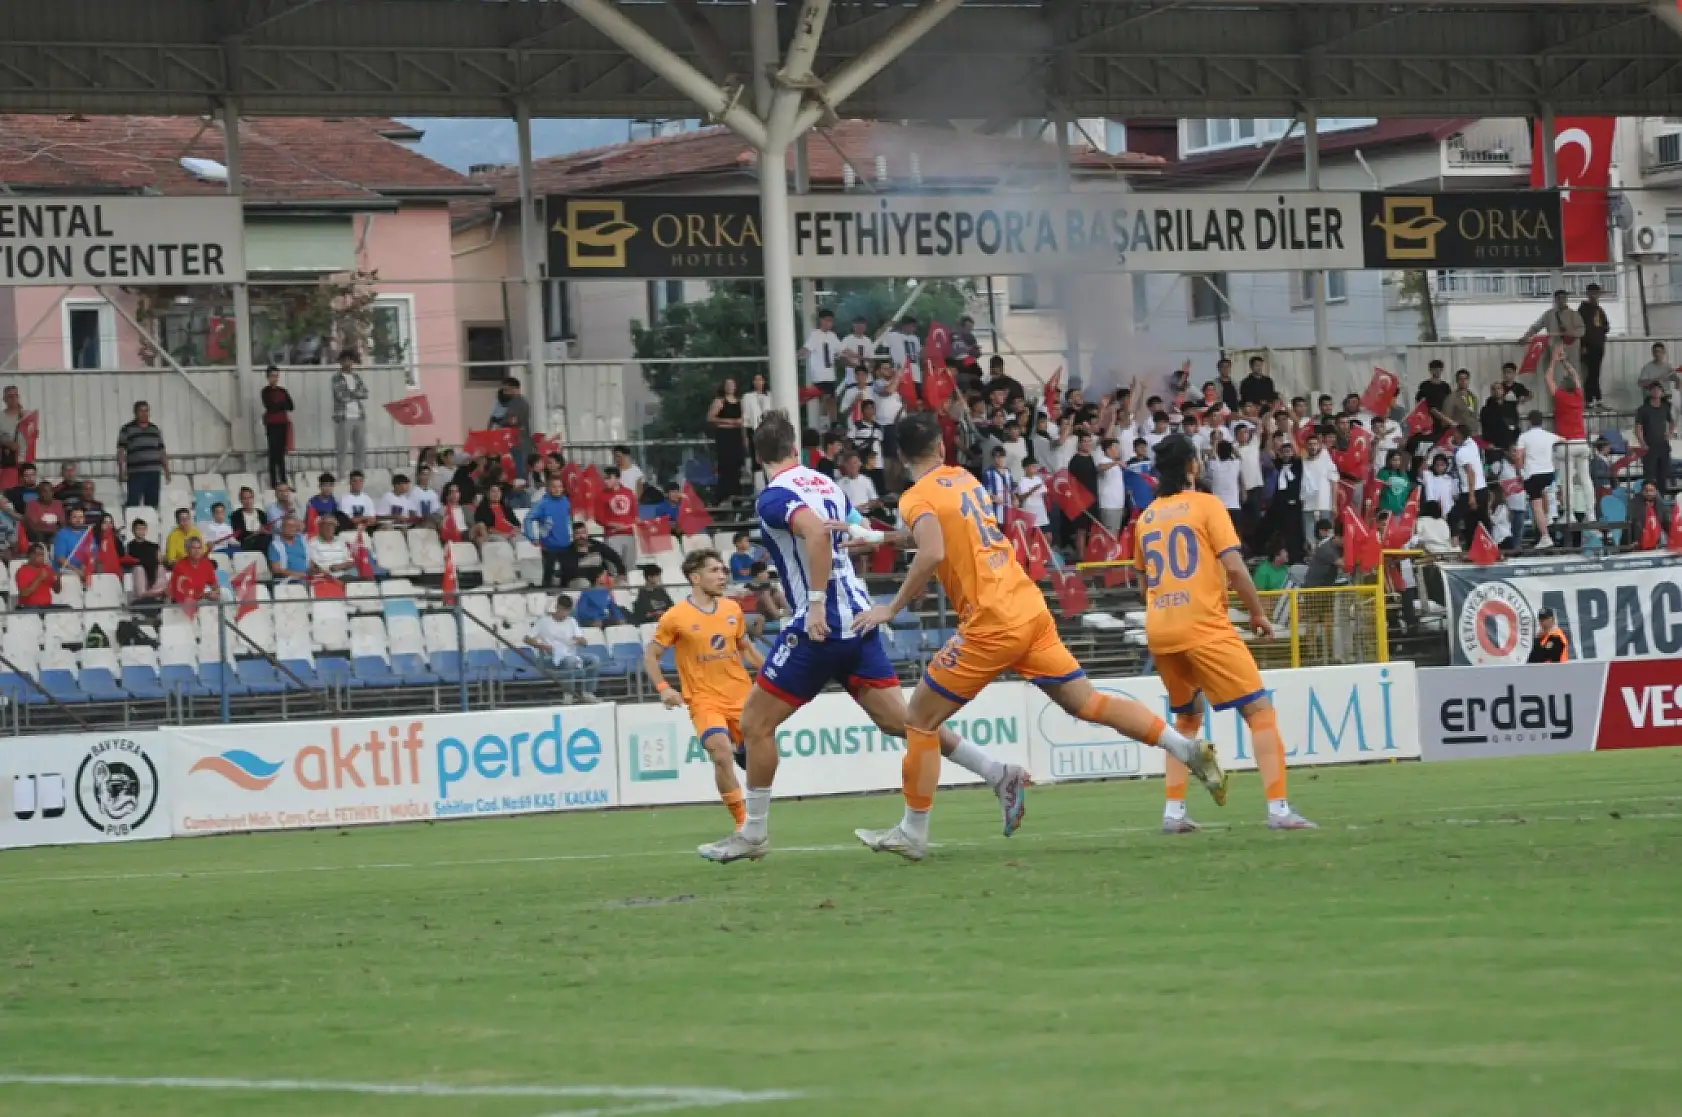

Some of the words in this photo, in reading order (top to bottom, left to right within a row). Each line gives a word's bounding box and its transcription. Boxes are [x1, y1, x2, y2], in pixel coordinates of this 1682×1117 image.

[0, 205, 113, 238] ENTAL
[652, 212, 763, 248] ORKA
[794, 198, 1059, 256] FETHİYESPOR'A
[1065, 207, 1247, 266] BAŞARILAR
[1254, 195, 1345, 250] DİLER
[1458, 208, 1554, 242] ORKA
[0, 243, 73, 278] ION
[84, 242, 225, 278] CENTER
[671, 253, 749, 268] HOTELS
[1475, 245, 1543, 259] HOTELS
[1142, 524, 1199, 588] 50
[1541, 580, 1682, 661] APAC
[1440, 683, 1574, 740] erday
[776, 715, 1018, 758] CONSTRION
[1492, 732, 1549, 744] GROUP
[294, 720, 424, 791] aktif
[436, 713, 603, 799] perde
[105, 823, 130, 837] PUB
